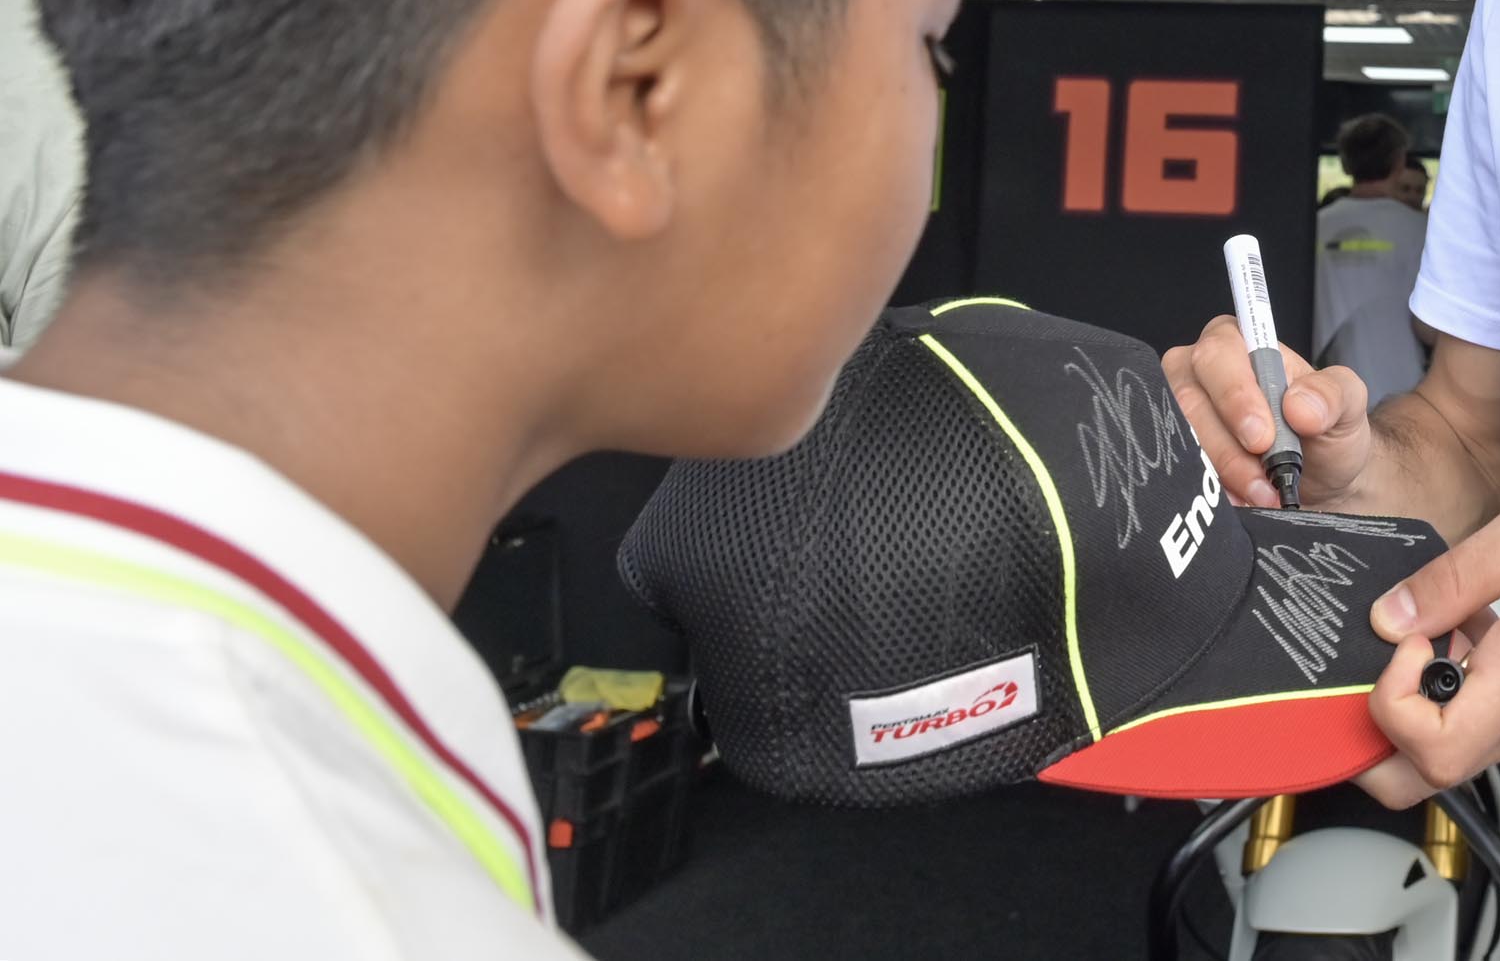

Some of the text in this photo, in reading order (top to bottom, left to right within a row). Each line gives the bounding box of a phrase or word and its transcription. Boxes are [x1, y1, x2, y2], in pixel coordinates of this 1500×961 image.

[1053, 77, 1240, 215] 16
[1160, 440, 1221, 579] End
[870, 699, 998, 743] TURBO
